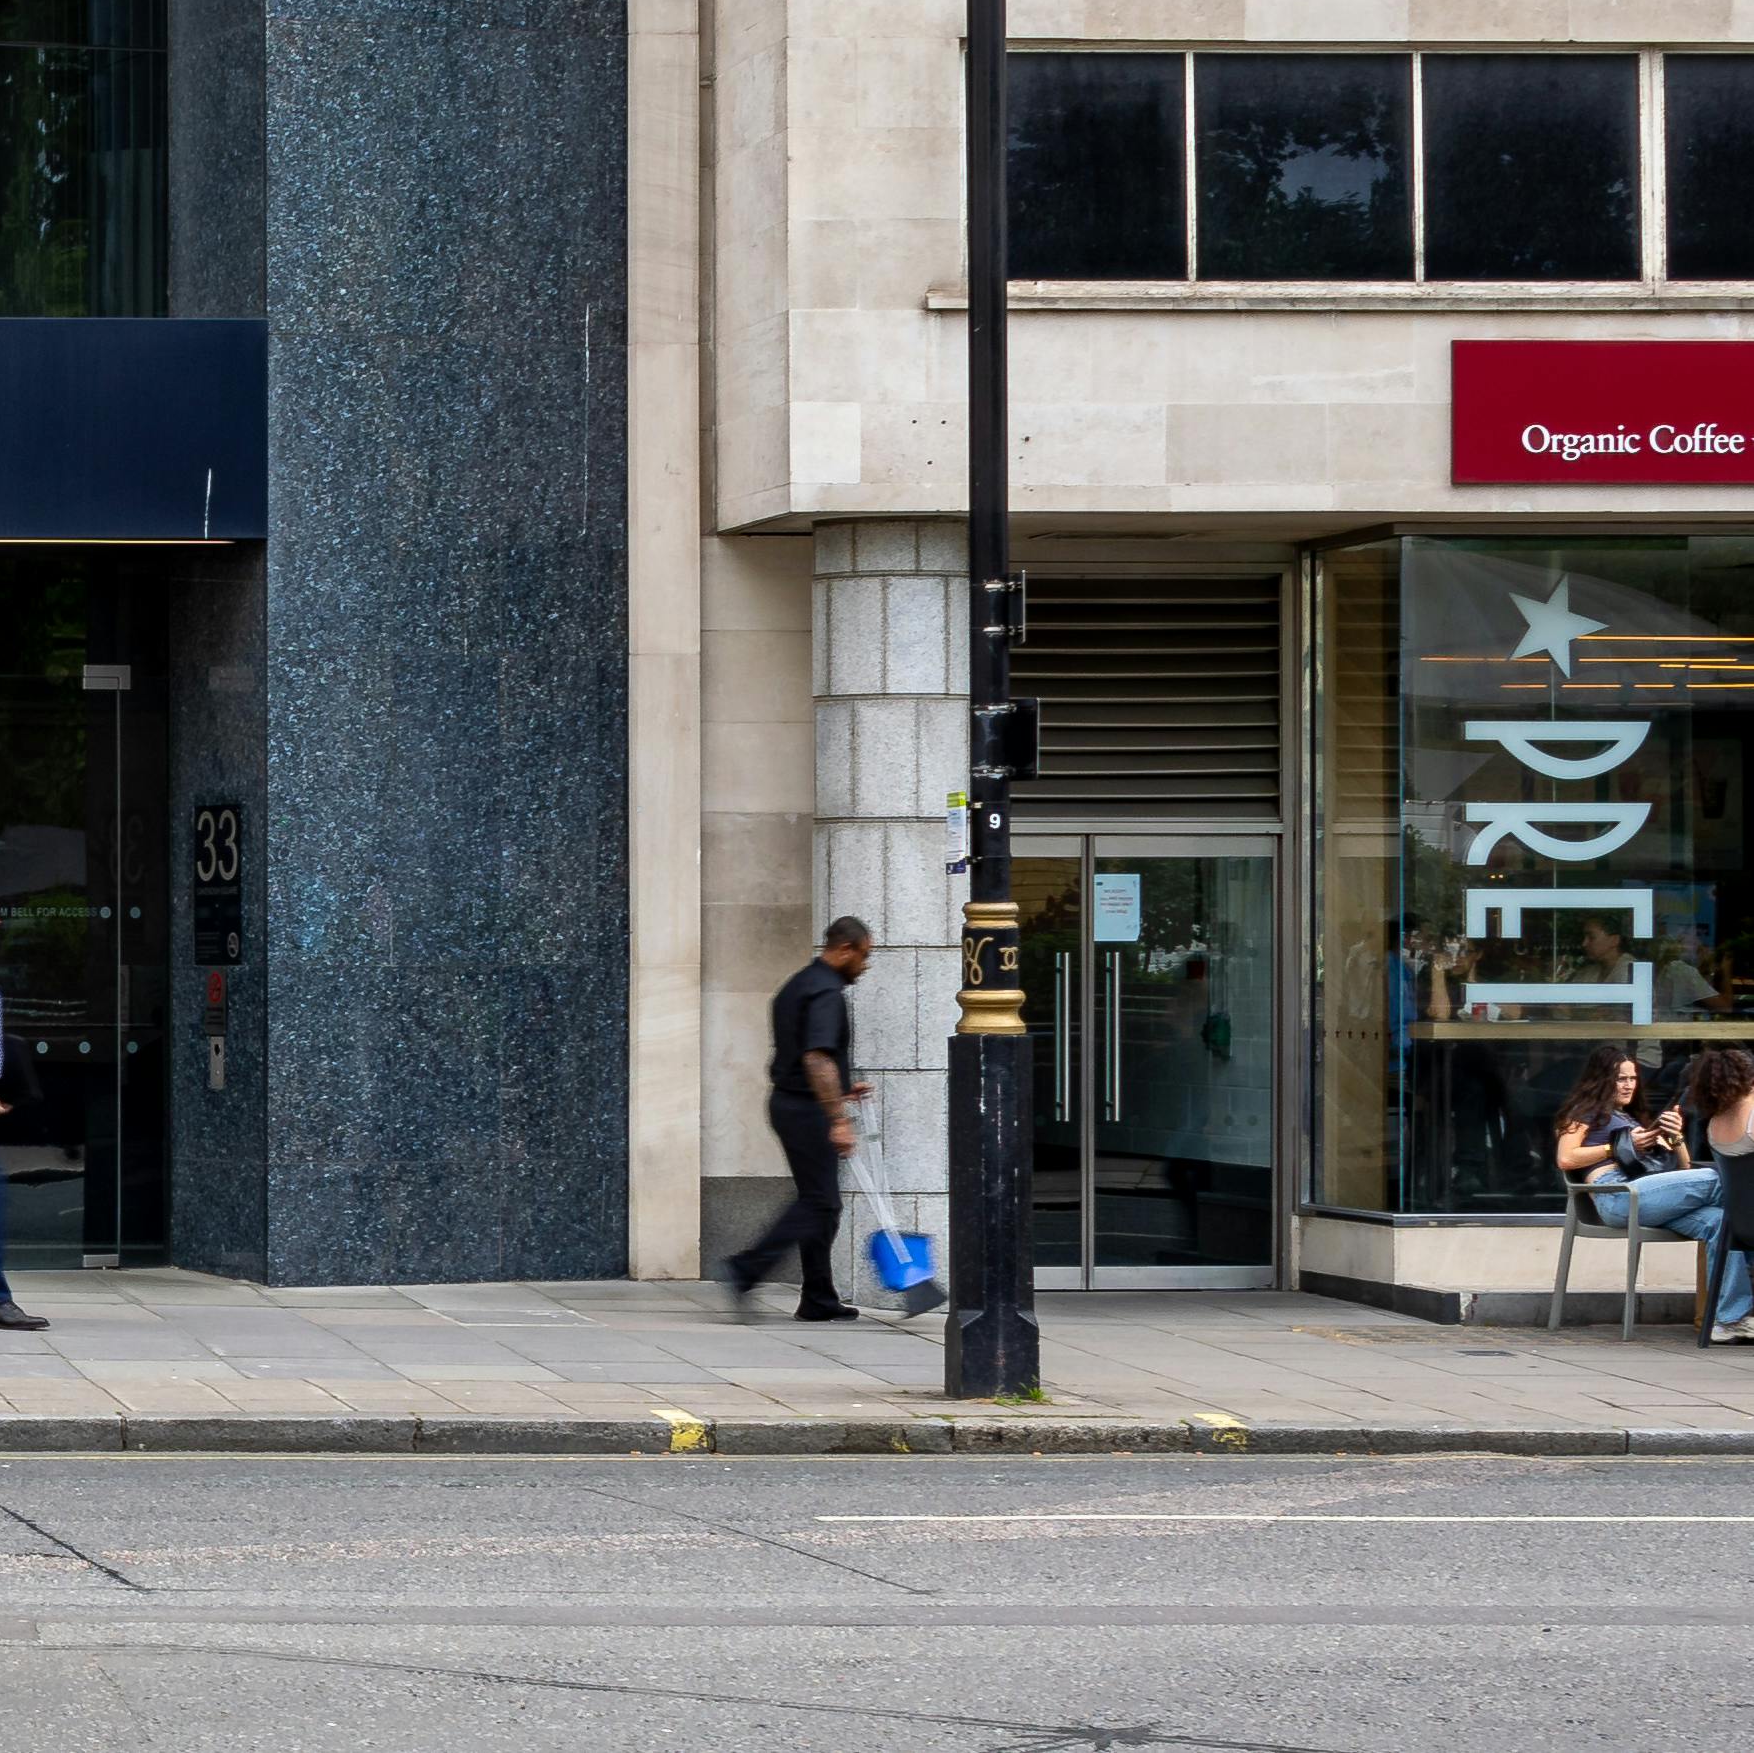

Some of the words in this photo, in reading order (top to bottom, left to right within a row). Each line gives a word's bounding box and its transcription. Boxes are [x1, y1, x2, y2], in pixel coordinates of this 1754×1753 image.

[1521, 424, 1641, 461] Organic
[1649, 423, 1745, 454] Coffee
[989, 813, 1001, 829] 9
[197, 809, 238, 881] 33
[1464, 721, 1654, 1026] PRET
[10, 908, 34, 917] BELL
[36, 908, 56, 917] FOR
[59, 908, 97, 917] ACCESS
